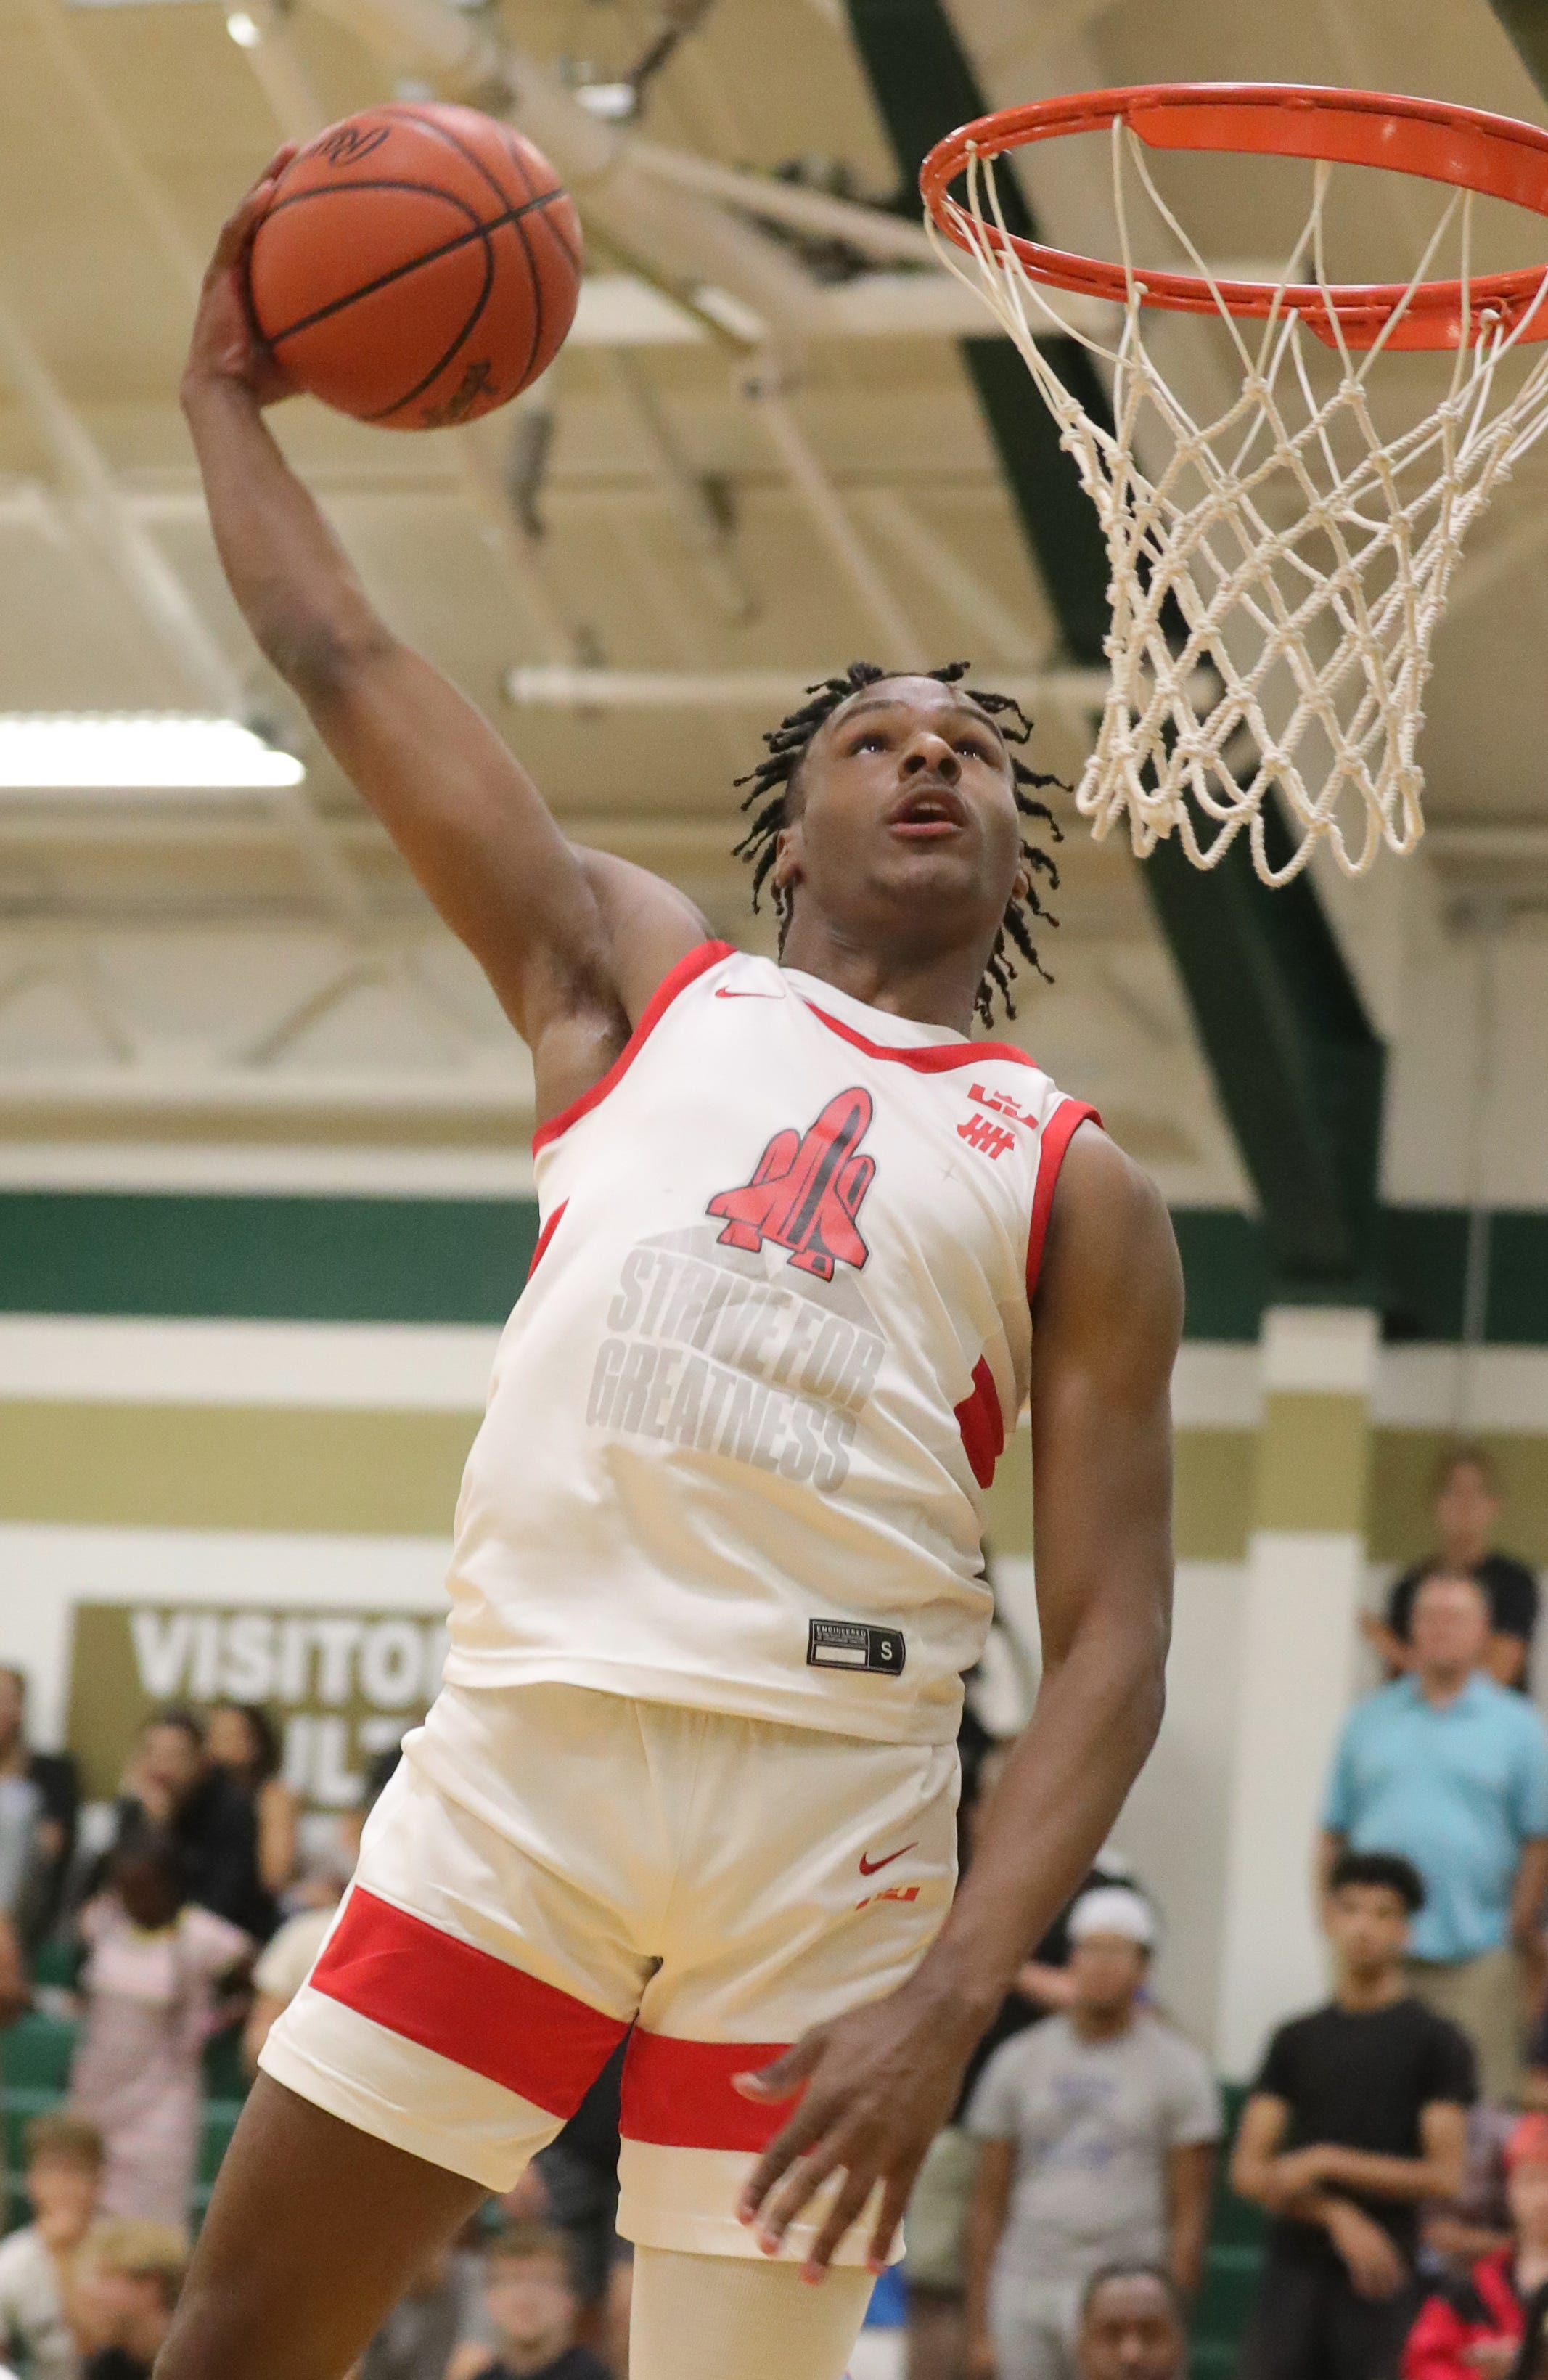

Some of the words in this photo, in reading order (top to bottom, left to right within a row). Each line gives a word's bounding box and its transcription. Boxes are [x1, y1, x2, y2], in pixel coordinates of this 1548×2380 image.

[606, 1248, 794, 1376] STRIVE
[772, 1299, 886, 1414] FOR
[585, 1337, 858, 1492] GREATNESS
[880, 1640, 893, 1661] S
